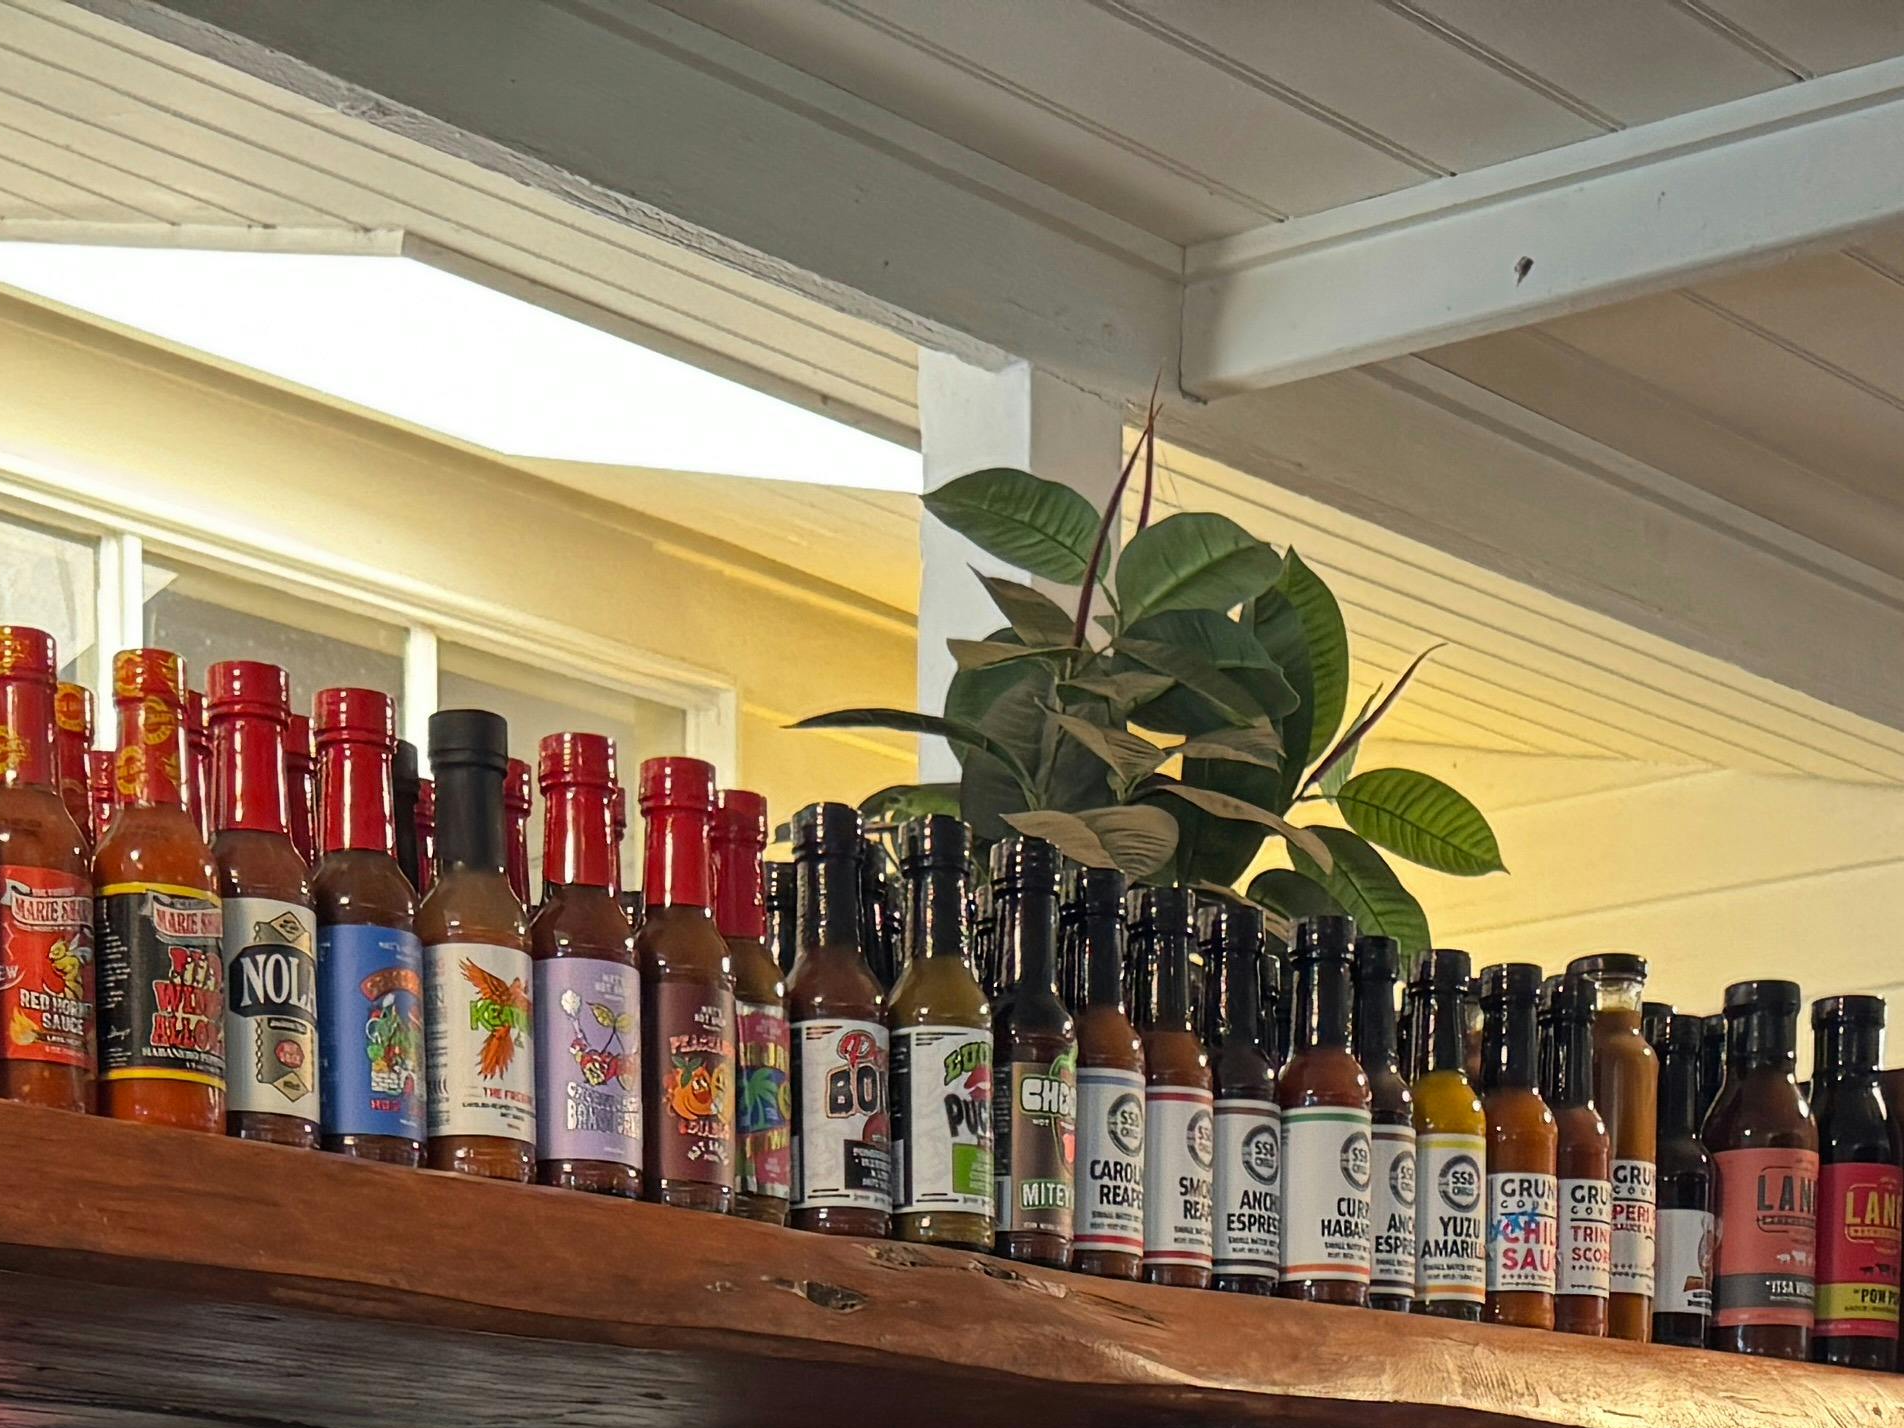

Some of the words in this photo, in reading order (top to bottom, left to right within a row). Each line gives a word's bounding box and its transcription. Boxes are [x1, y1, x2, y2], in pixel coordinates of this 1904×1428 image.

[21, 989, 48, 1010] RED
[42, 1012, 85, 1035] SAUCE
[1439, 1216, 1480, 1238] YUZU
